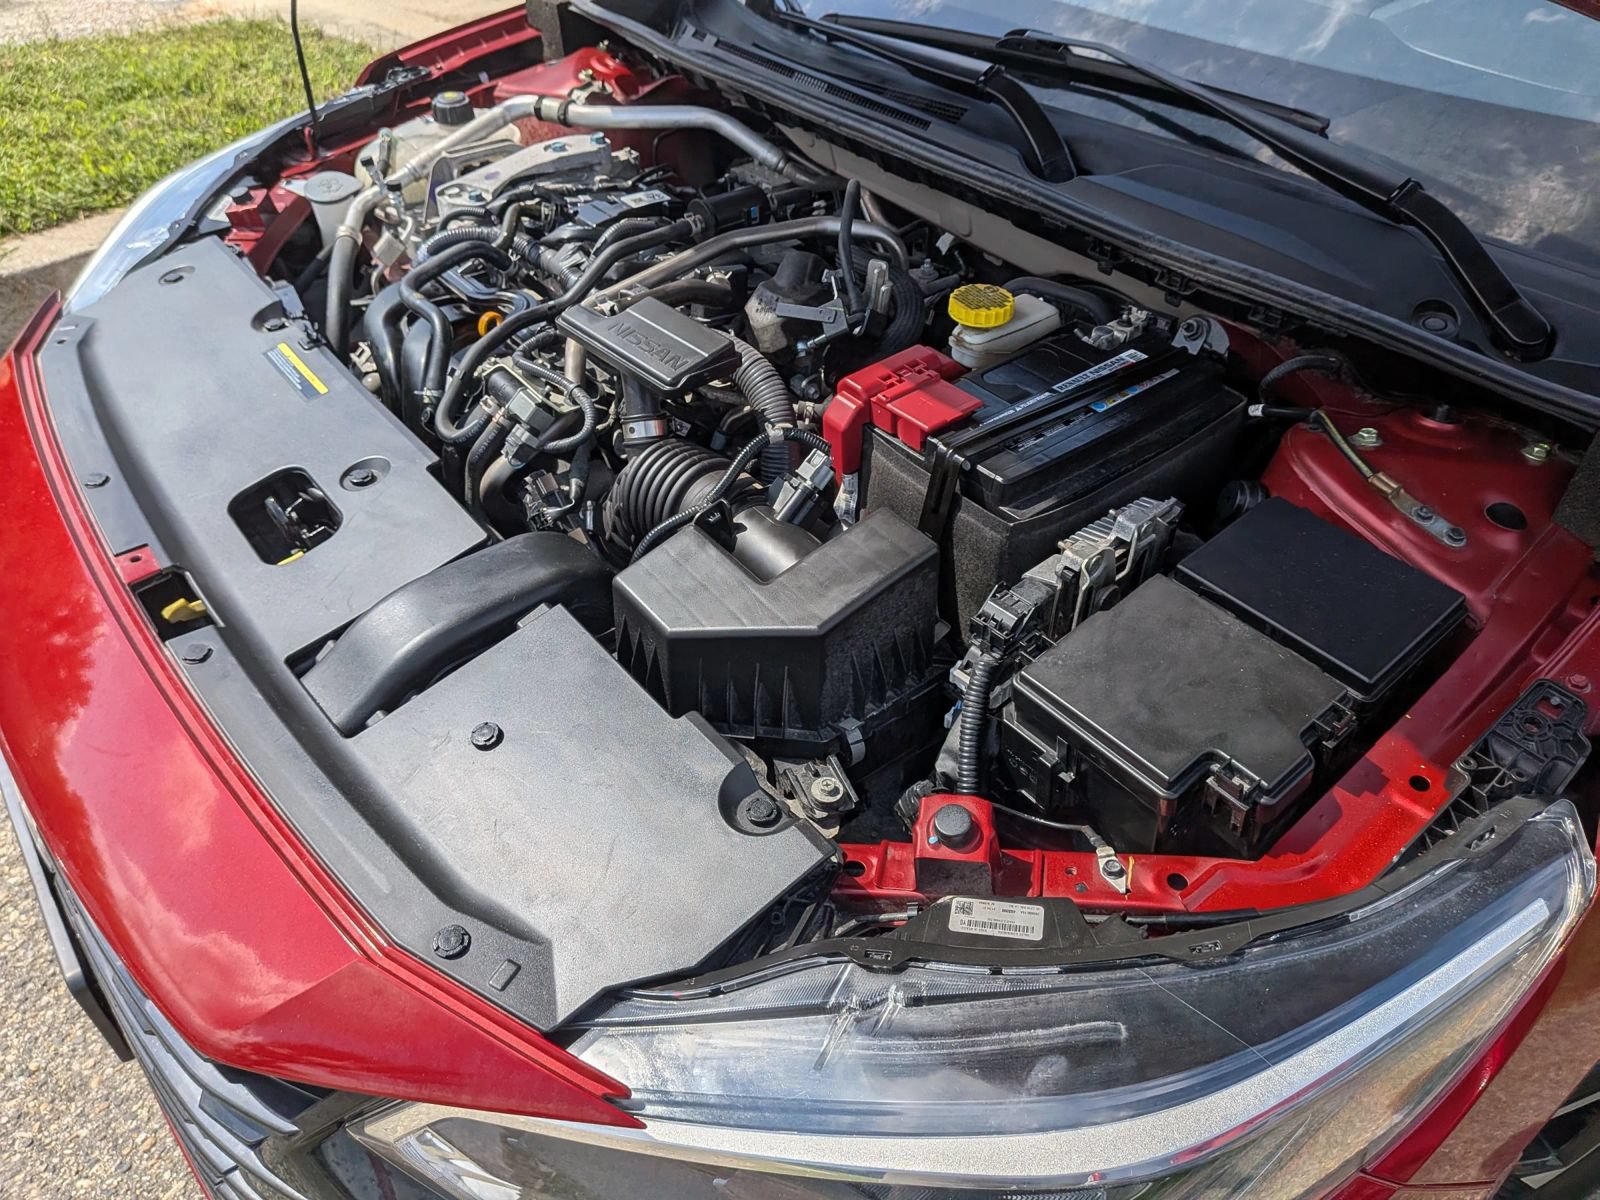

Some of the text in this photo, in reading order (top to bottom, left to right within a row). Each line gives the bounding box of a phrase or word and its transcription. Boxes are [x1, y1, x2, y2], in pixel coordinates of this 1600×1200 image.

[608, 322, 689, 371] NISSAN
[1056, 373, 1091, 391] RENAULT
[1089, 356, 1125, 376] NISSAN
